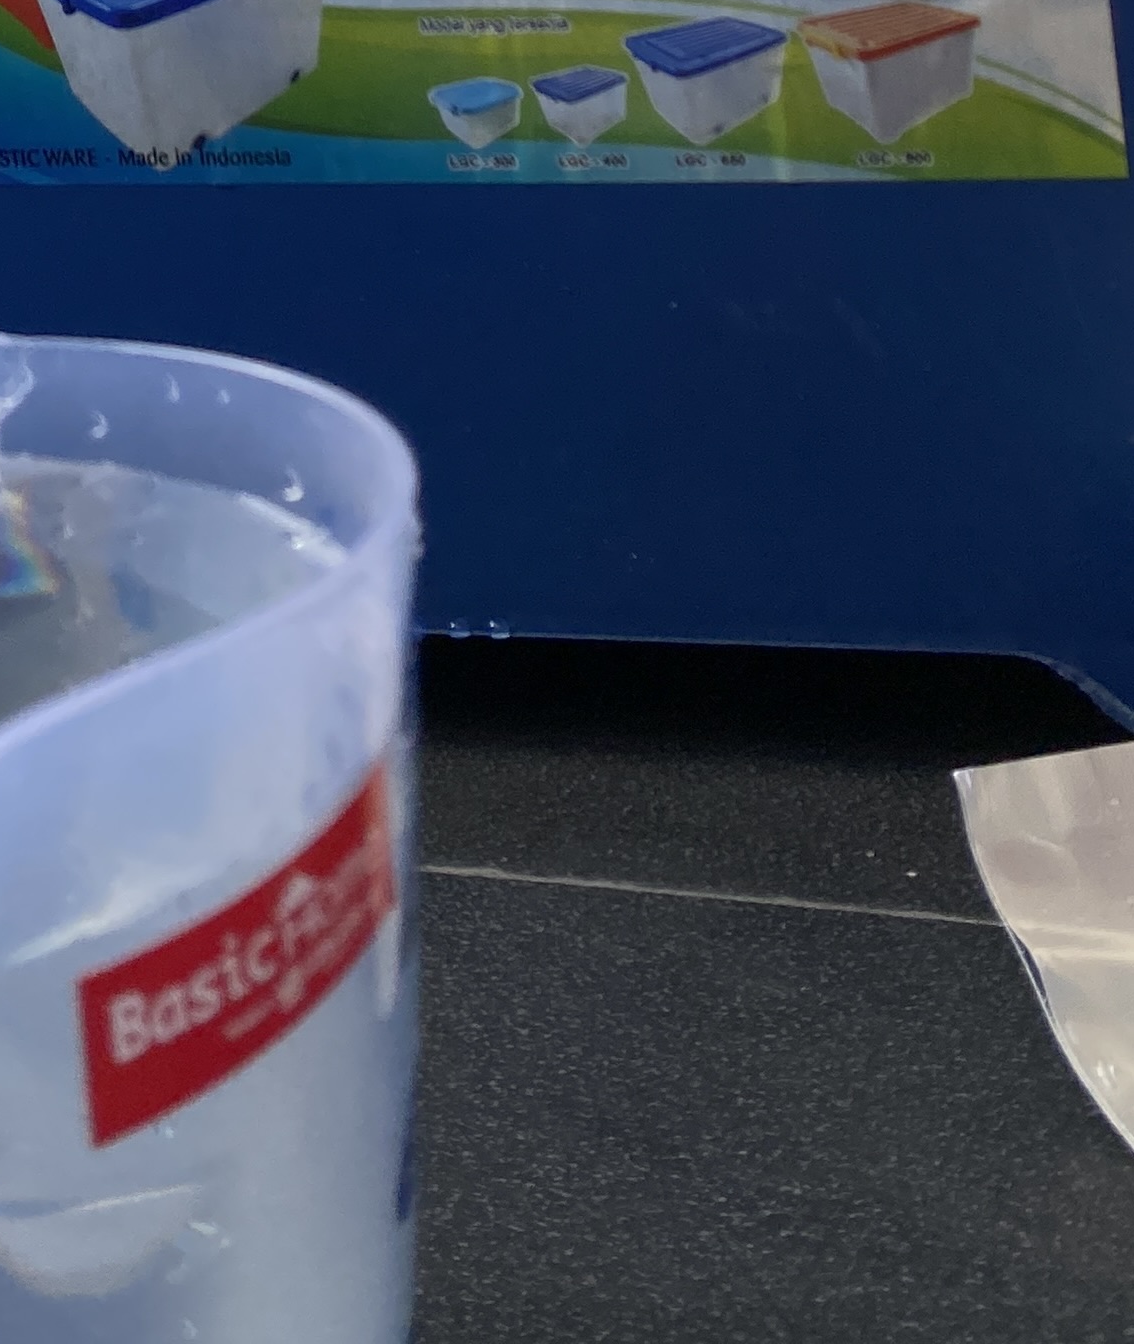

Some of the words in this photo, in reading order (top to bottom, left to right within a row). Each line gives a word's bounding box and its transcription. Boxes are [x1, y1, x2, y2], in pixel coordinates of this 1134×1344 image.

[43, 147, 98, 166] WARE
[118, 146, 170, 166] Made
[199, 144, 292, 166] Indonesia
